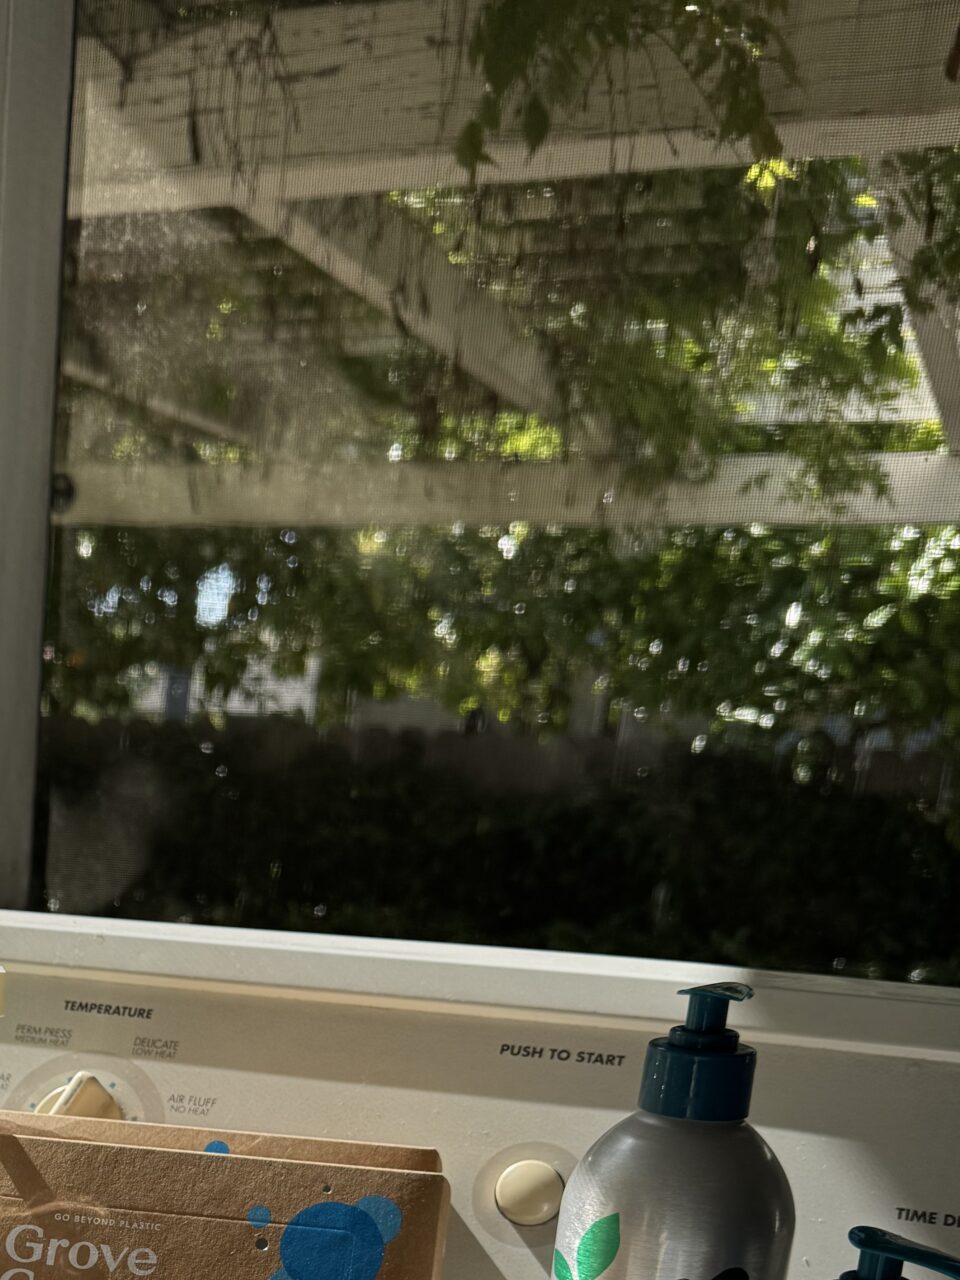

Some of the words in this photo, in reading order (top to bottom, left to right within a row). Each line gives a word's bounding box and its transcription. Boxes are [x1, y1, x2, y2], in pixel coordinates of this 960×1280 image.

[64, 1000, 153, 1020] TEMPERATURE
[15, 1024, 41, 1036] PERM
[43, 1027, 73, 1039] PRESS
[14, 1034, 47, 1045] MEDIUM
[48, 1038, 70, 1047] HEAT
[133, 1037, 179, 1051] DELICATE
[132, 1047, 153, 1057] LOW
[154, 1050, 177, 1059] HEAT
[500, 1043, 544, 1058] PUSH
[549, 1048, 571, 1061] TO
[576, 1051, 626, 1066] START
[168, 1094, 186, 1105] AIR
[188, 1096, 217, 1109] FLUFF
[170, 1104, 186, 1114] NO
[187, 1107, 211, 1117] HEAT
[54, 1213, 70, 1222] GO
[74, 1215, 115, 1227] BEYOND
[120, 1220, 161, 1231] PLASTIC
[895, 1207, 938, 1224] TIME
[5, 1224, 158, 1276] Grove
